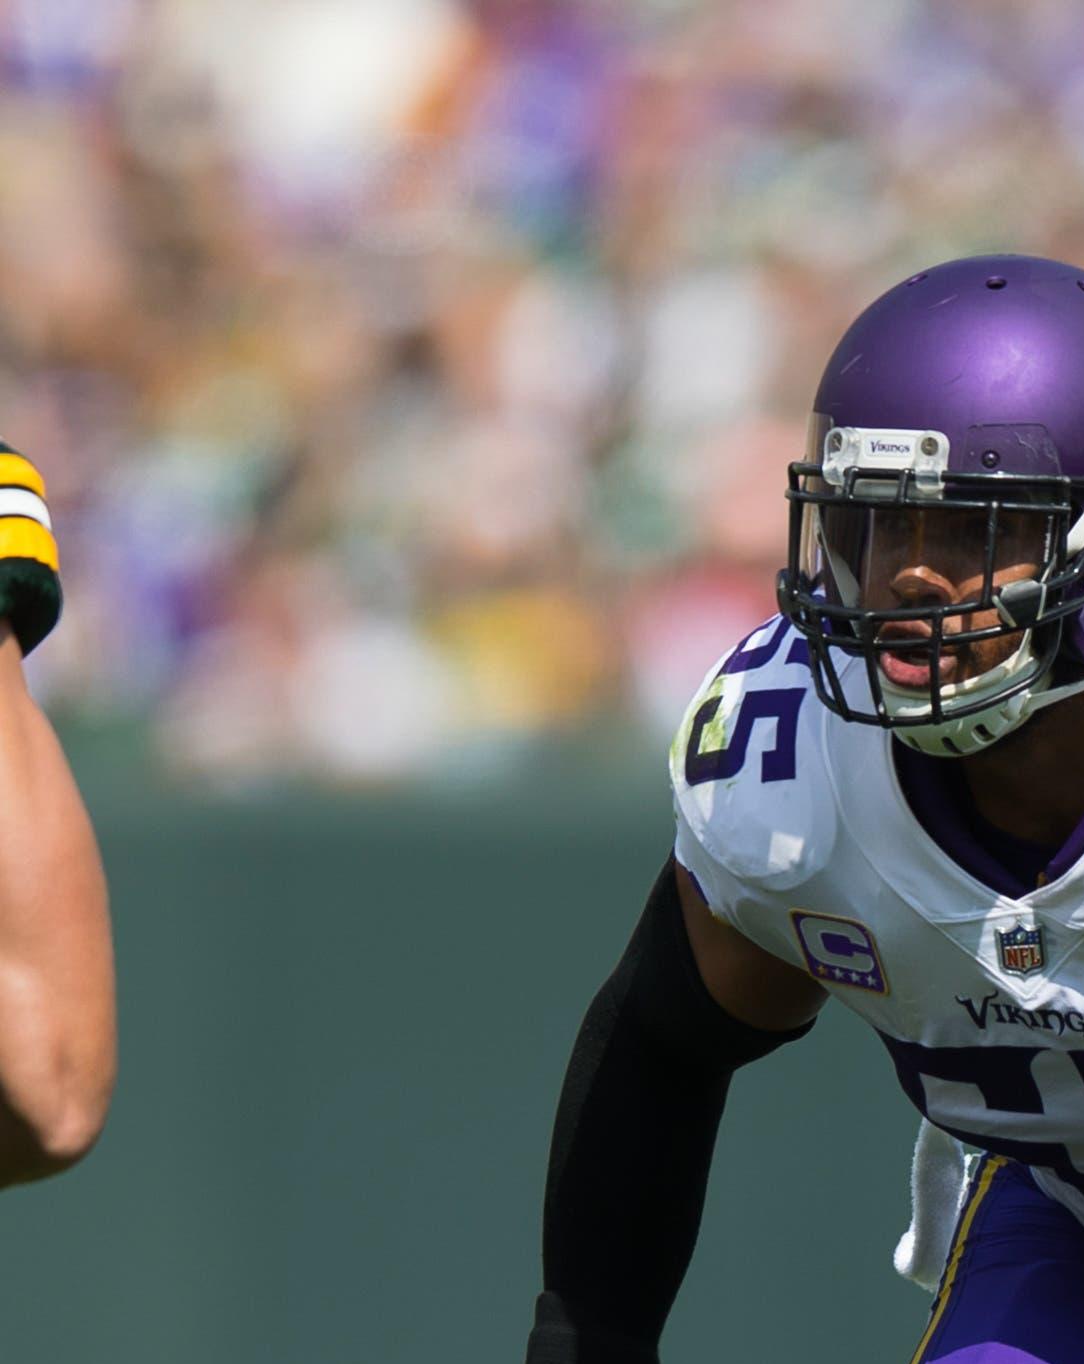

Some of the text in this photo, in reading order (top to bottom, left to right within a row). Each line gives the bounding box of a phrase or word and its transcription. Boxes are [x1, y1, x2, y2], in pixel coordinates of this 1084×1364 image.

[870, 440, 911, 453] VIKINGS
[800, 917, 874, 973] C
[1003, 945, 1041, 971] NFL
